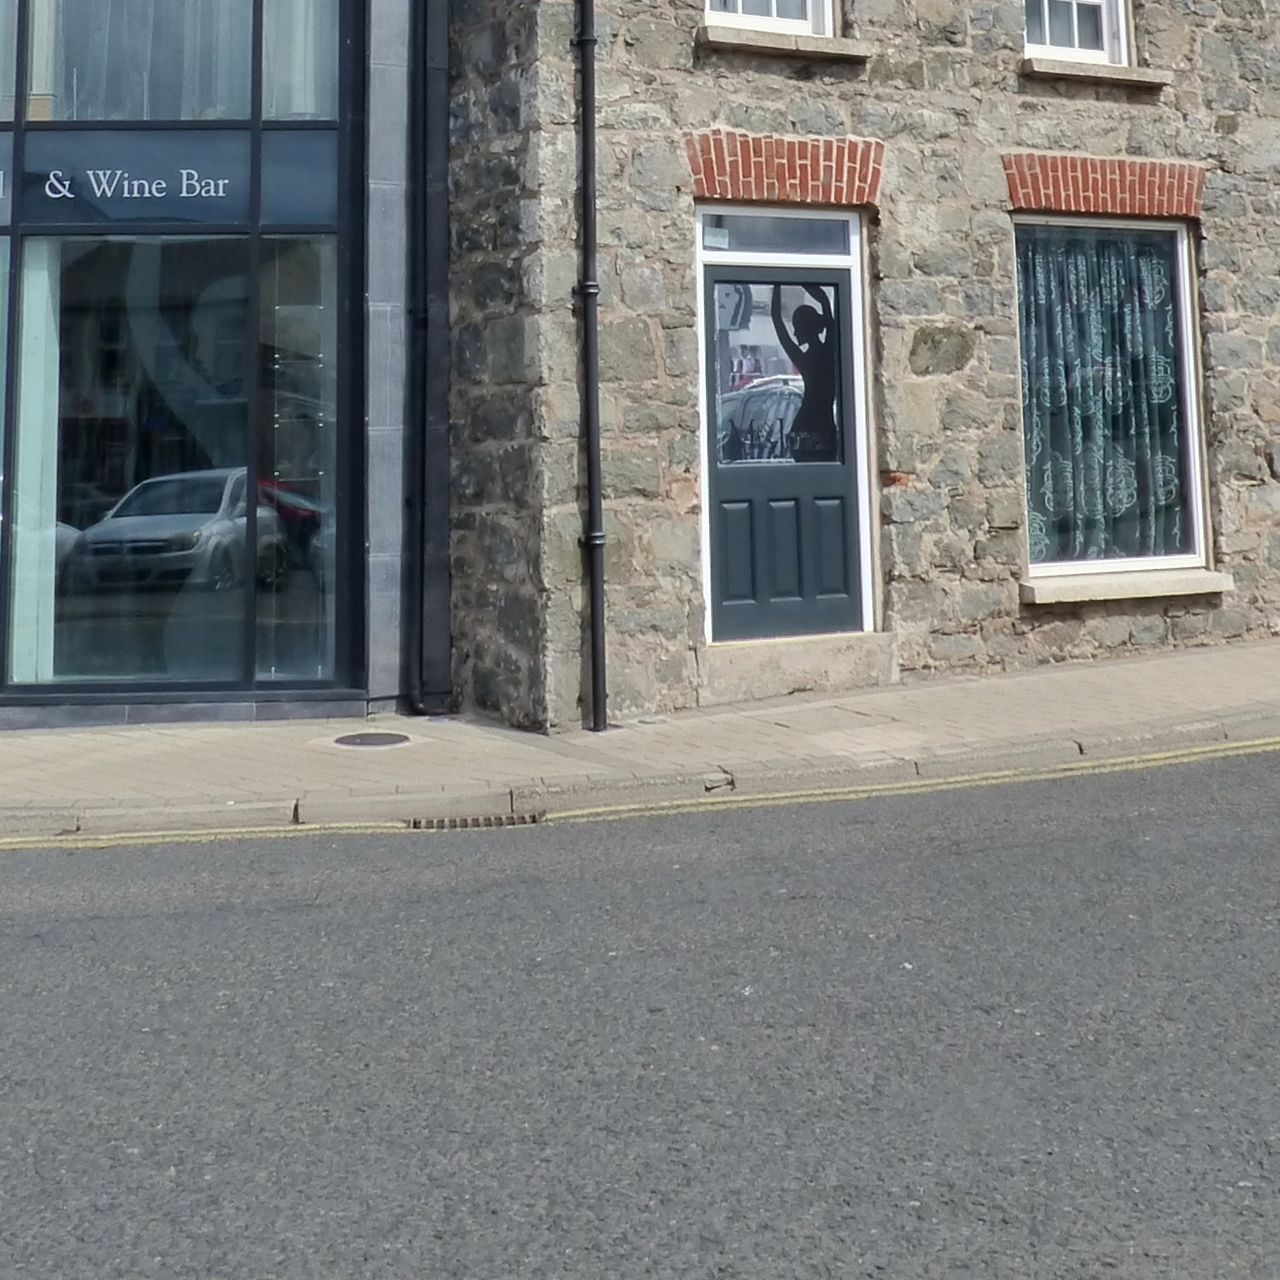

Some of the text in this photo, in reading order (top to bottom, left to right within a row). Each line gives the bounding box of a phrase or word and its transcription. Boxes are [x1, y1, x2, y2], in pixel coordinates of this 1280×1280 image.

[44, 170, 75, 199] &
[86, 169, 168, 198] Wine
[179, 169, 230, 198] Bar
